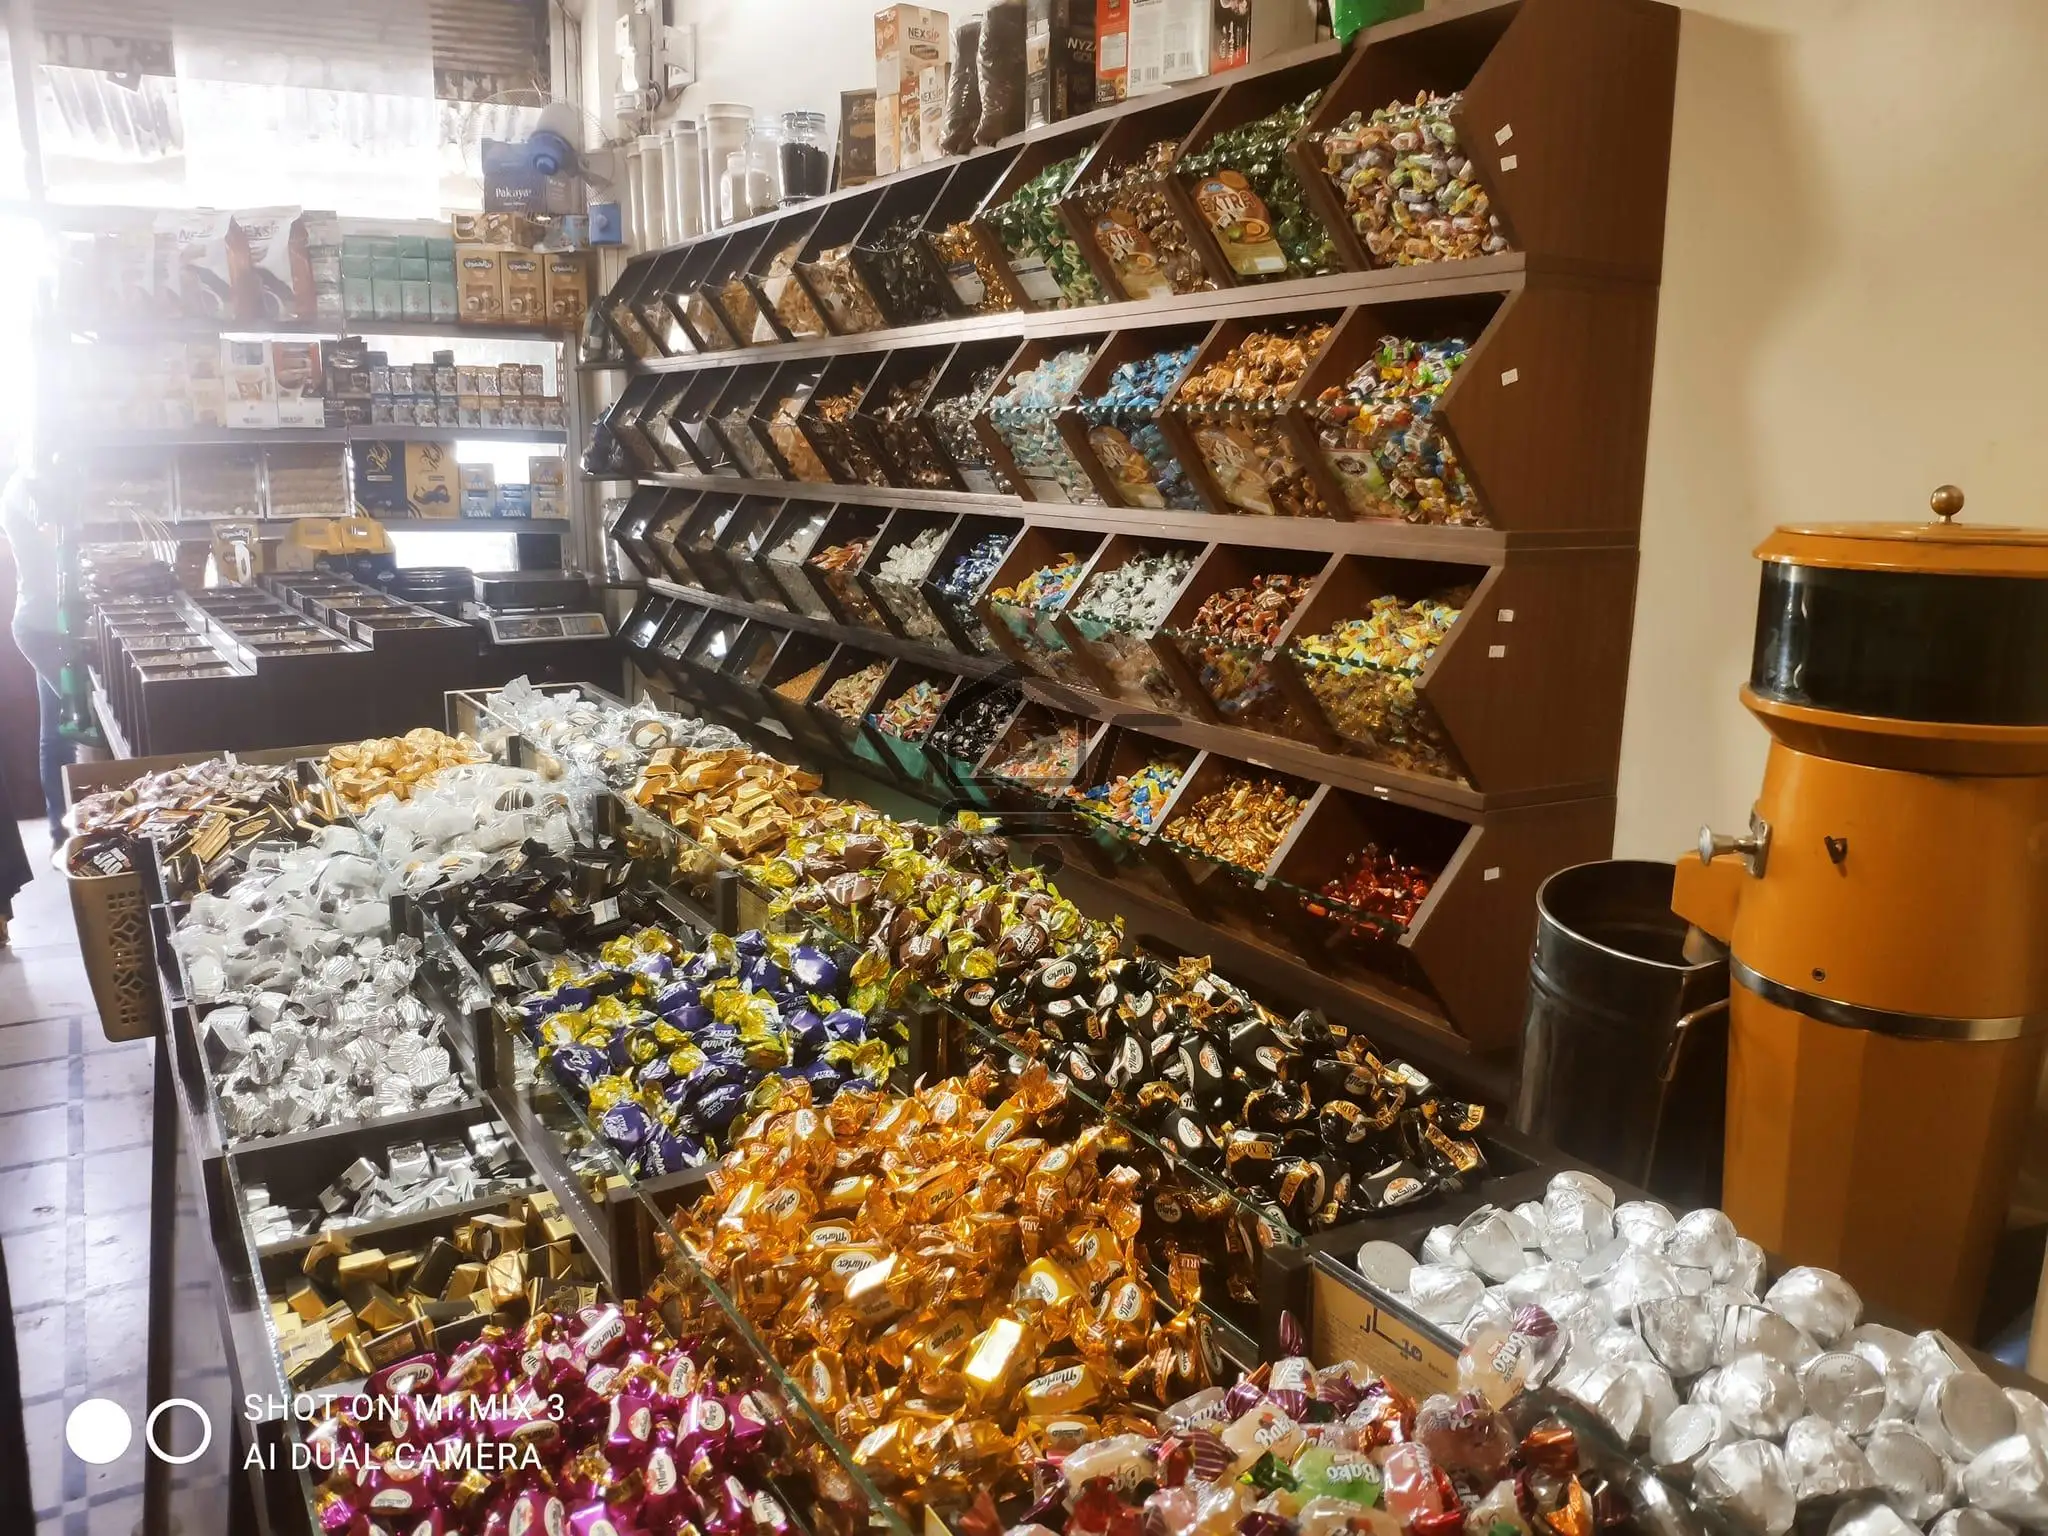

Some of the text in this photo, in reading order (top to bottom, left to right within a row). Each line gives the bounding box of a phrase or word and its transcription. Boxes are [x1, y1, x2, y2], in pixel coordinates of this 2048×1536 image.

[1201, 191, 1256, 213] EXTRA
[815, 1231, 848, 1243] Marlex
[1326, 1462, 1381, 1485] Bako
